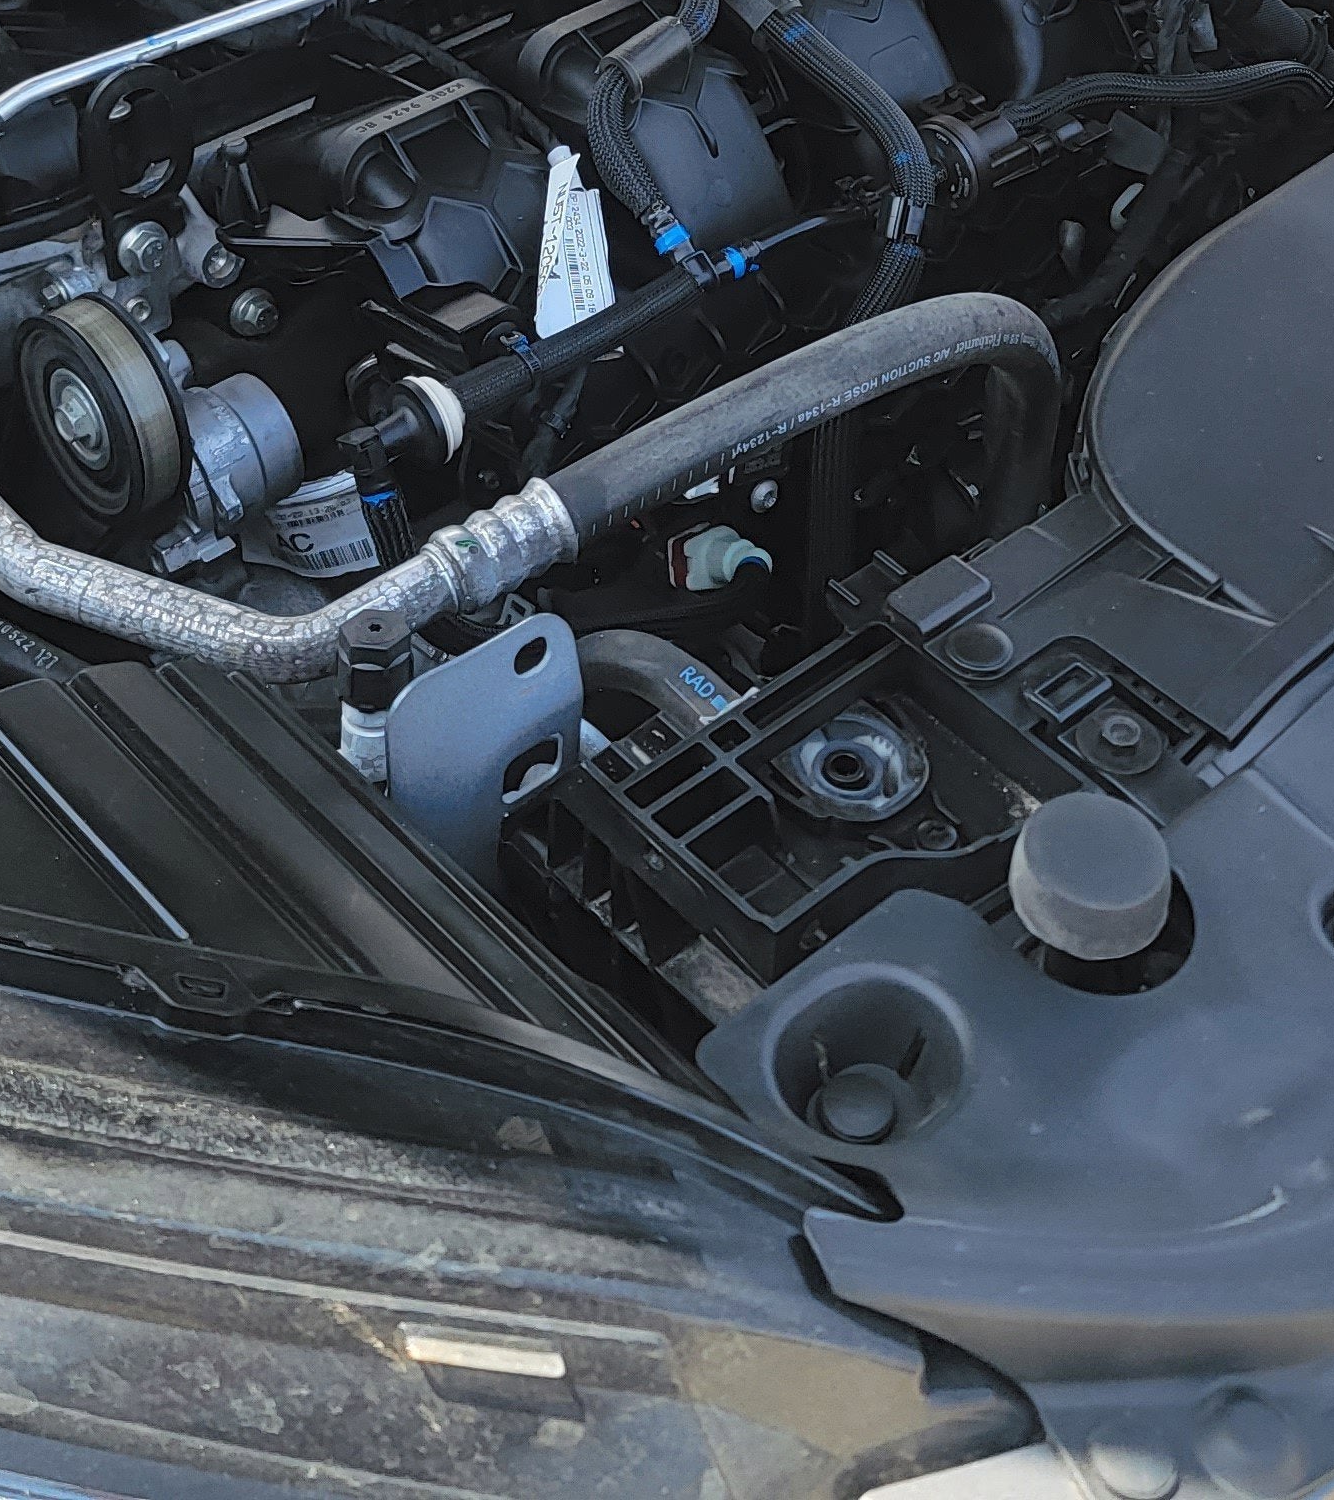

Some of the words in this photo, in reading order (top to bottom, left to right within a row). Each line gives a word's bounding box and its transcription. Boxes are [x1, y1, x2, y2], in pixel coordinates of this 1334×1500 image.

[933, 346, 950, 362] A/C
[880, 354, 930, 384] SUCTION
[843, 377, 876, 401] HOSE
[798, 394, 840, 422] R-134a
[731, 421, 786, 458] R-1234yf
[677, 663, 718, 700] RAD
